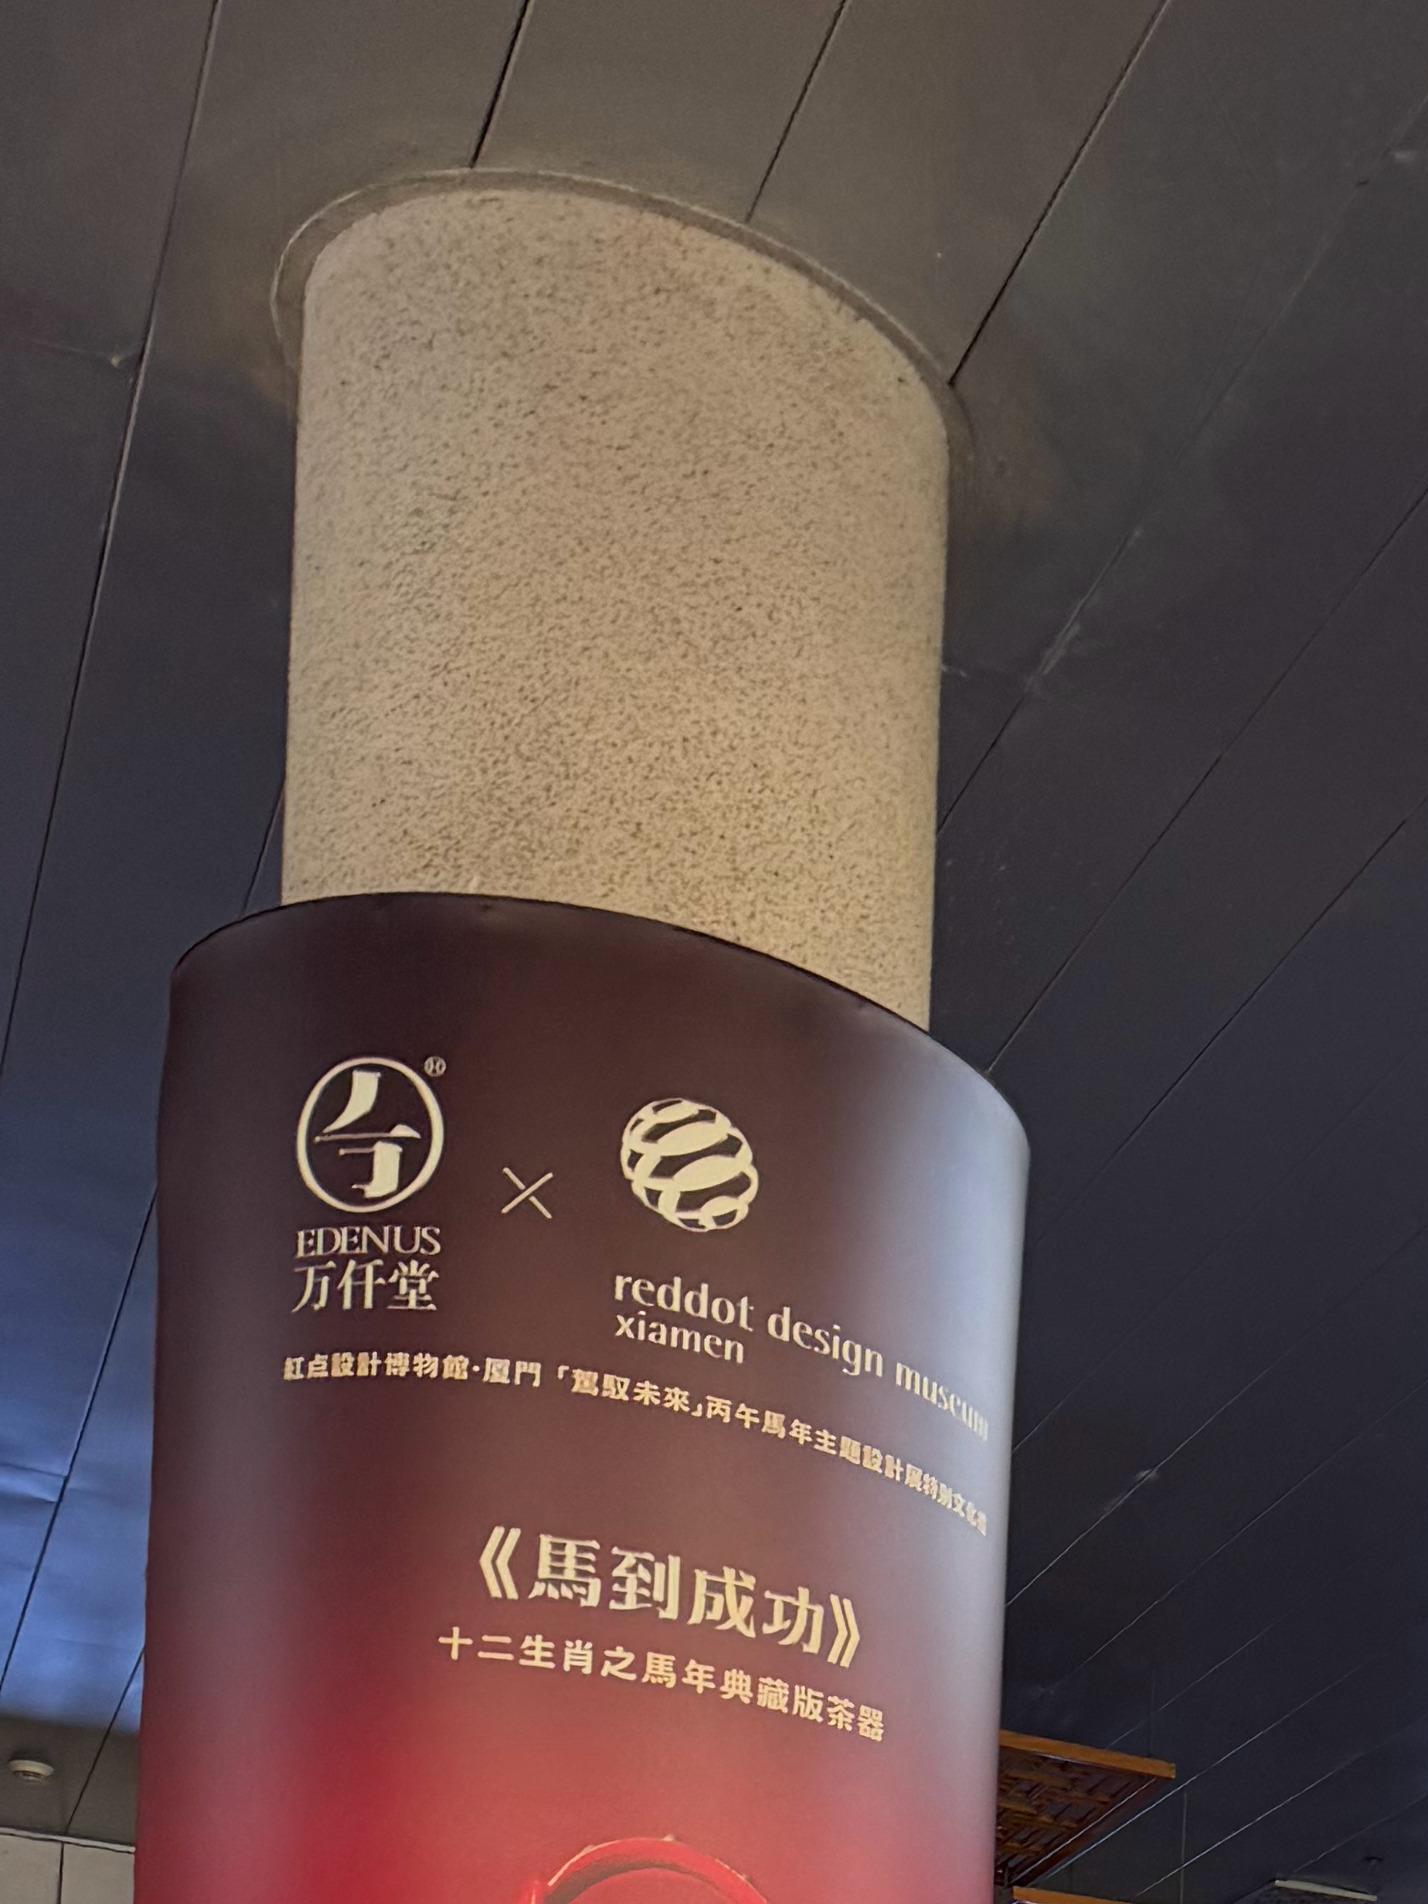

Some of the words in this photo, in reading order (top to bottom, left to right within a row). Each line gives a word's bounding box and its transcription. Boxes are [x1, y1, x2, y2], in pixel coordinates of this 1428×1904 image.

[295, 1224, 442, 1259] EDENUS
[291, 1258, 440, 1313] 万仟堂
[613, 1274, 754, 1333] reddot
[766, 1306, 884, 1378] design
[894, 1361, 990, 1441] museum
[614, 1310, 745, 1364] xiamen
[478, 1525, 862, 1669] 《馬到成功》
[437, 1625, 886, 1743] 十二生肖之馬年典藏版茶器
